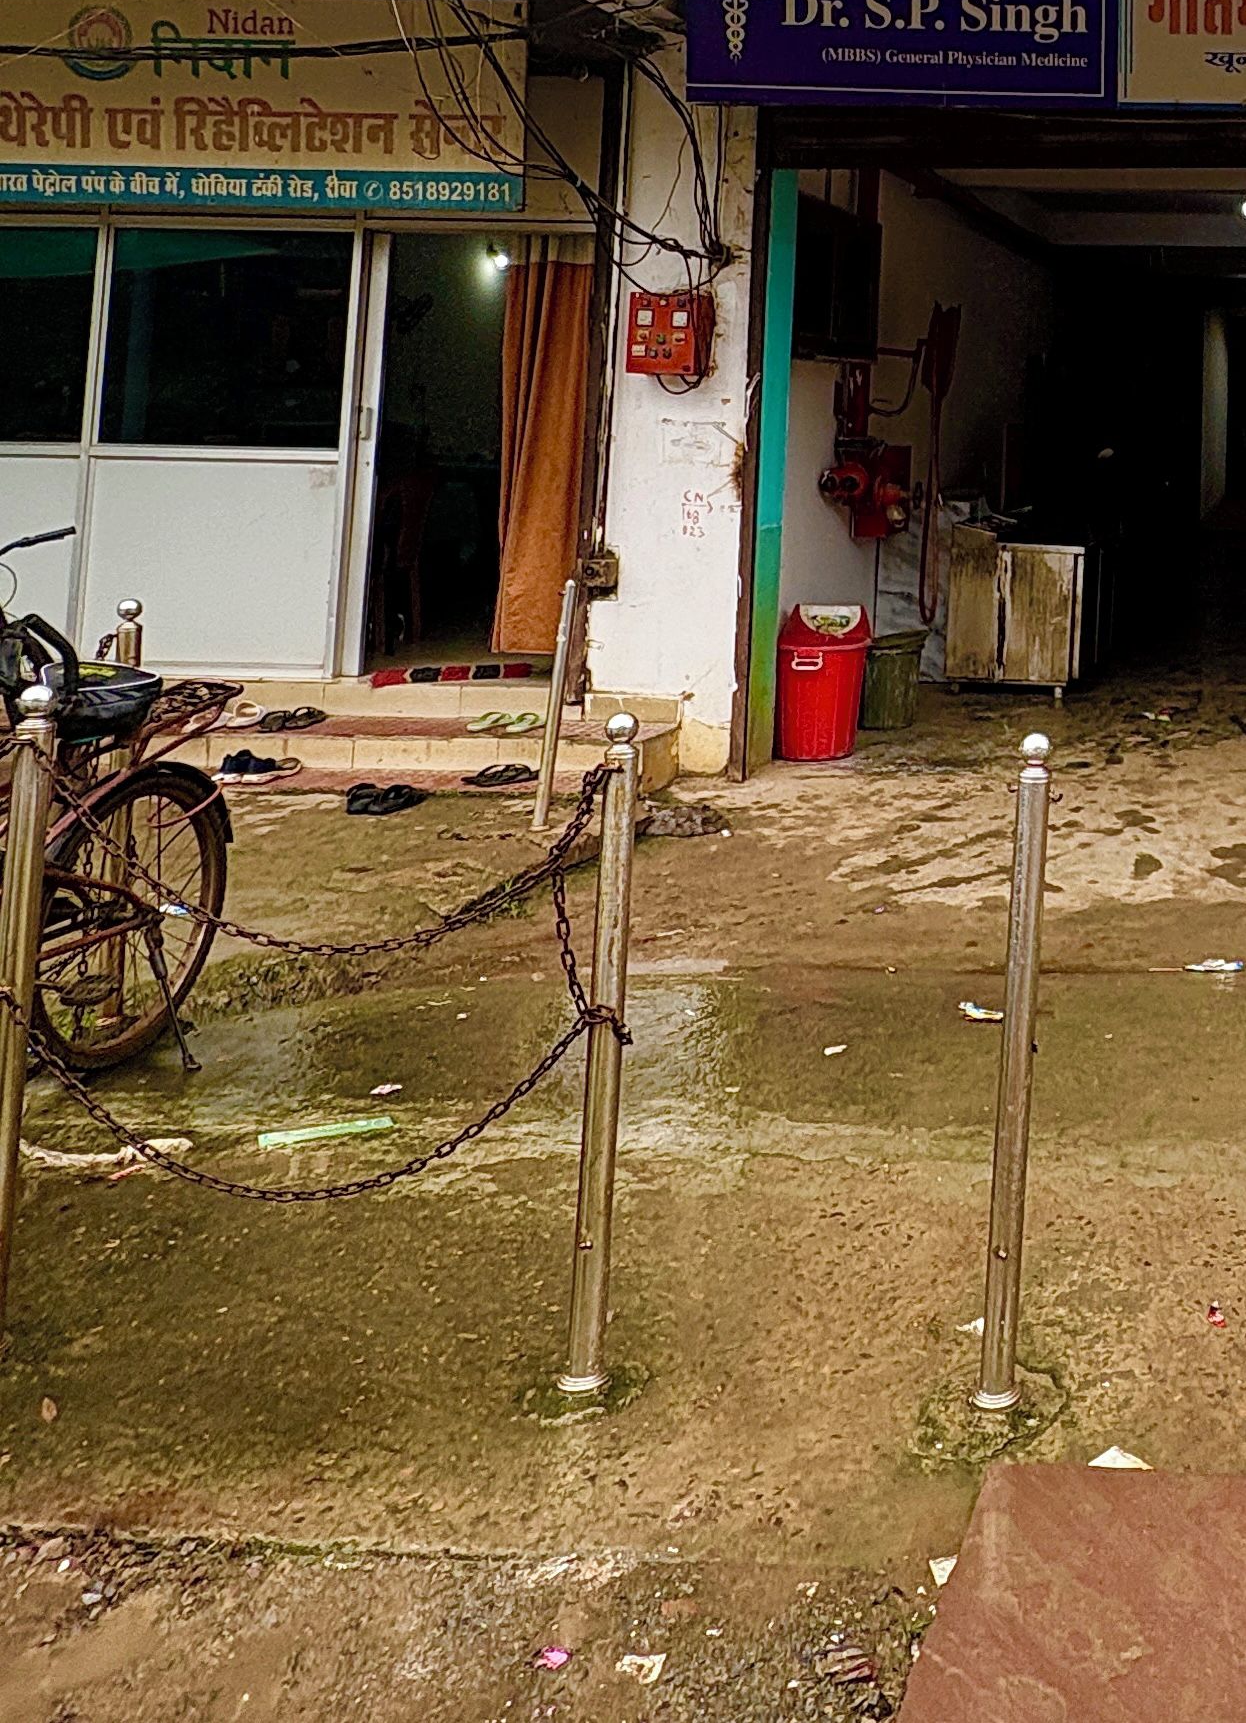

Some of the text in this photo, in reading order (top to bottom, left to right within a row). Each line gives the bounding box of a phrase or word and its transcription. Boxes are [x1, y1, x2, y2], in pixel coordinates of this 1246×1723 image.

[206, 8, 296, 36] Nidan
[151, 20, 297, 80] निदान
[821, 46, 1090, 69] (MBBS) General Physician Medicine
[104, 95, 165, 150] एवं
[0, 172, 29, 194] ारत
[32, 169, 79, 197] पेट्रोल
[81, 170, 107, 194] पंप
[108, 170, 126, 195] के
[251, 172, 285, 198] टंकी
[287, 174, 320, 203] रोड,
